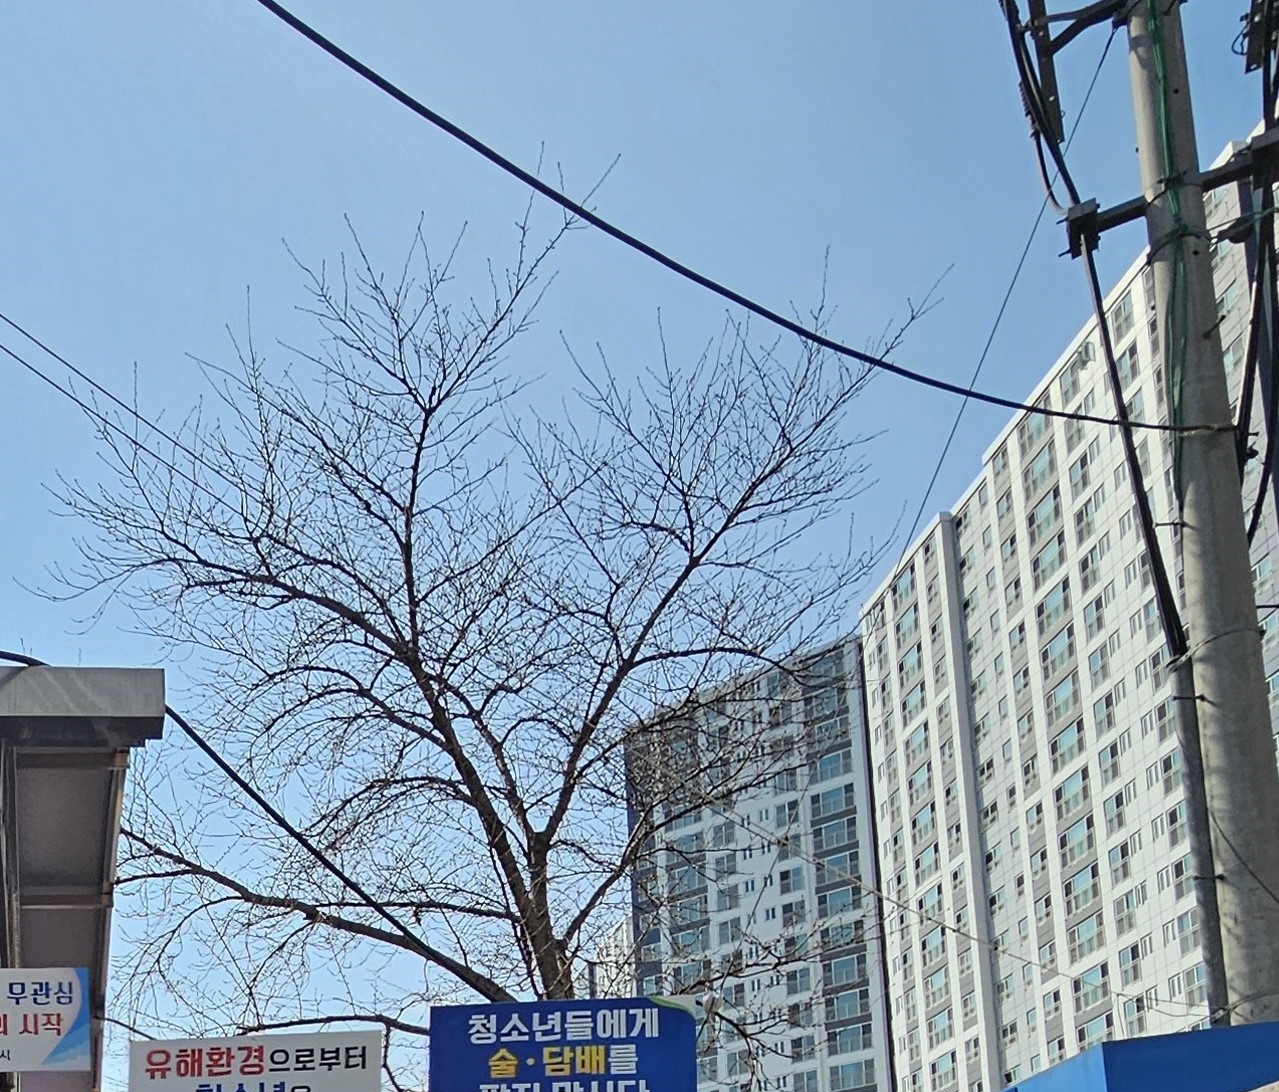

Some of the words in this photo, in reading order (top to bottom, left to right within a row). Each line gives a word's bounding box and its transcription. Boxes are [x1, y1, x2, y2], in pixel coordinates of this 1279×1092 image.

[6, 980, 75, 1007] 무관심
[20, 1012, 64, 1038] 시작
[468, 1009, 660, 1042] 청소년들에게
[145, 1043, 368, 1081] 유해환경으로부터
